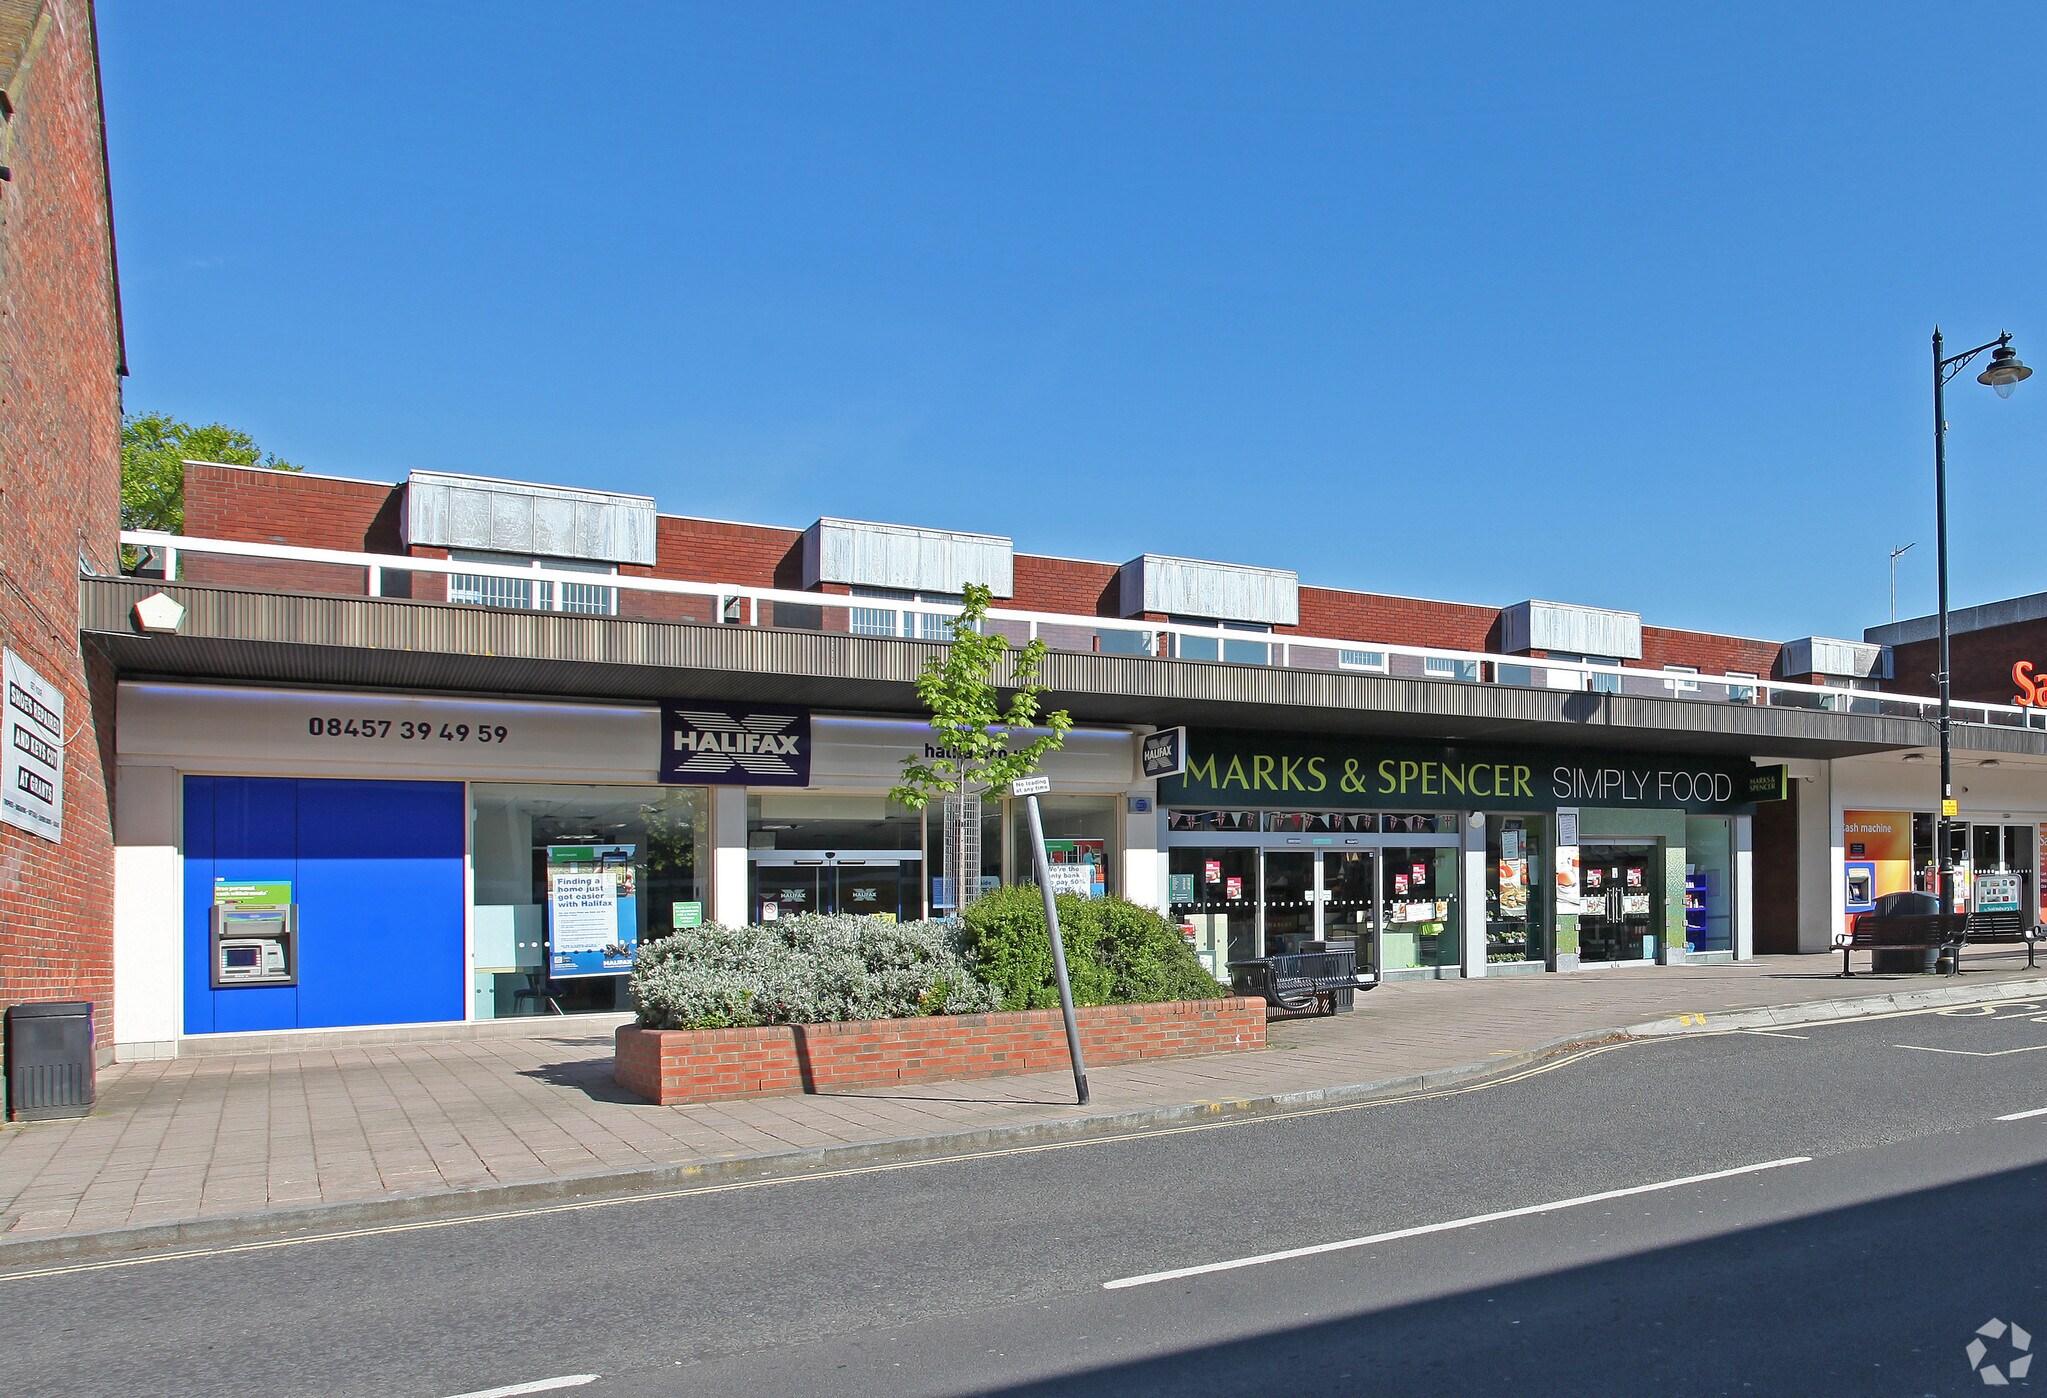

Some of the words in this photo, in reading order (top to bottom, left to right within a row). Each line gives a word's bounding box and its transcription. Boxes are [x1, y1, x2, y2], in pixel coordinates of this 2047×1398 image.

[11, 685, 33, 715] SHOES
[34, 700, 59, 732] REPAIRED
[309, 717, 392, 738] 08457
[400, 721, 432, 740] 39
[439, 723, 469, 742] 49
[478, 725, 508, 743] 59
[15, 727, 30, 747] AND
[30, 736, 46, 761] KEYS
[674, 730, 800, 755] HALIFAX
[1144, 745, 1172, 761] HALIFAX
[19, 770, 29, 788] AT
[30, 774, 53, 803] GRANTS
[1025, 779, 1047, 787] loading
[1183, 753, 1328, 792] MARKS
[1340, 758, 1367, 793] &
[1378, 759, 1534, 798] SPENCER
[1552, 766, 1650, 800] SIMPLY
[1658, 771, 1732, 801] FOOD
[1749, 783, 1776, 792] SPENCER
[1861, 823, 1892, 833] machine
[557, 878, 592, 886] Finding
[586, 885, 604, 893] just
